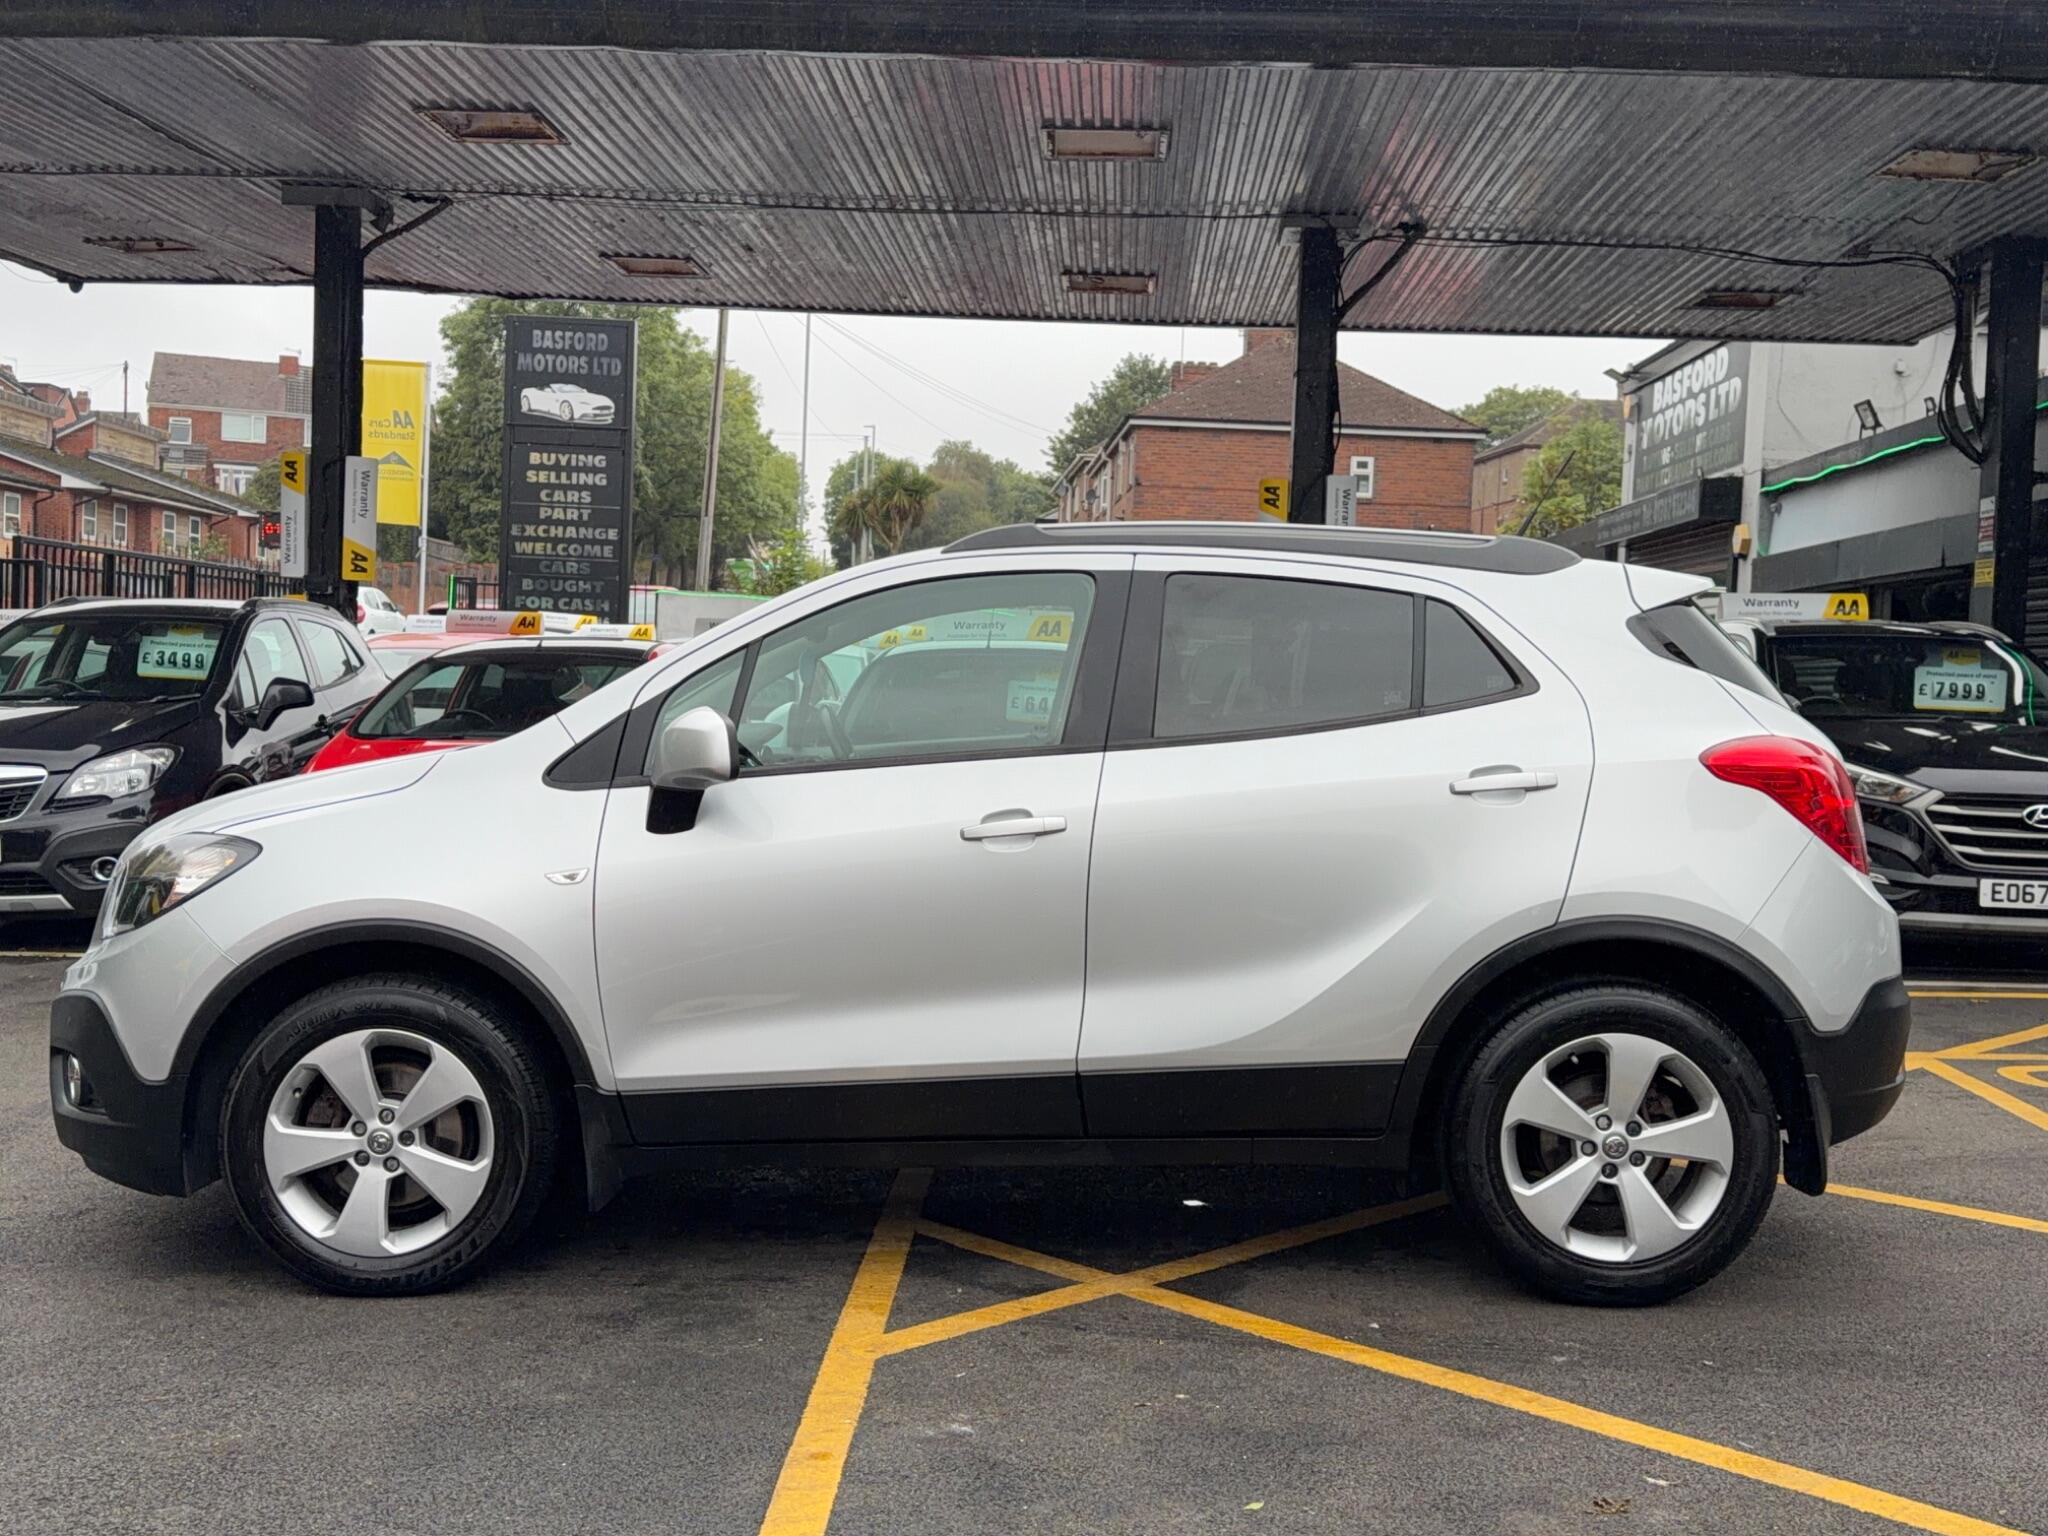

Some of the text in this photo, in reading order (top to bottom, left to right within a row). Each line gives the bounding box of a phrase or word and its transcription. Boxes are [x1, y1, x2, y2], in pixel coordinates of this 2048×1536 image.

[531, 329, 609, 351] BASFORD
[516, 353, 622, 377] MOTORS LTD
[1653, 346, 1729, 413] BASFORD
[1708, 376, 1742, 422] LTD
[528, 451, 607, 468] BUYING
[284, 460, 298, 483] AA
[525, 470, 607, 486] SELLING
[358, 469, 371, 519] Warranty
[539, 489, 592, 503] CARS
[1263, 486, 1280, 509] AA
[539, 506, 592, 521] PART
[284, 515, 293, 564] Warranty
[511, 523, 619, 540] EXCHANGE
[514, 541, 614, 558] WELCOME
[350, 550, 369, 573] AA
[539, 560, 592, 575] CARS
[521, 578, 606, 593] BOUGHT
[514, 595, 610, 612] FOR CASH
[1742, 598, 1860, 616] Warranty AA
[459, 614, 536, 629] Warranty AA
[953, 620, 1062, 637] Warranty AA
[633, 628, 649, 637] AA
[884, 635, 898, 645] AA
[911, 628, 923, 637] AA
[142, 650, 205, 670] £ 3499
[1918, 682, 1986, 700] £ 7999
